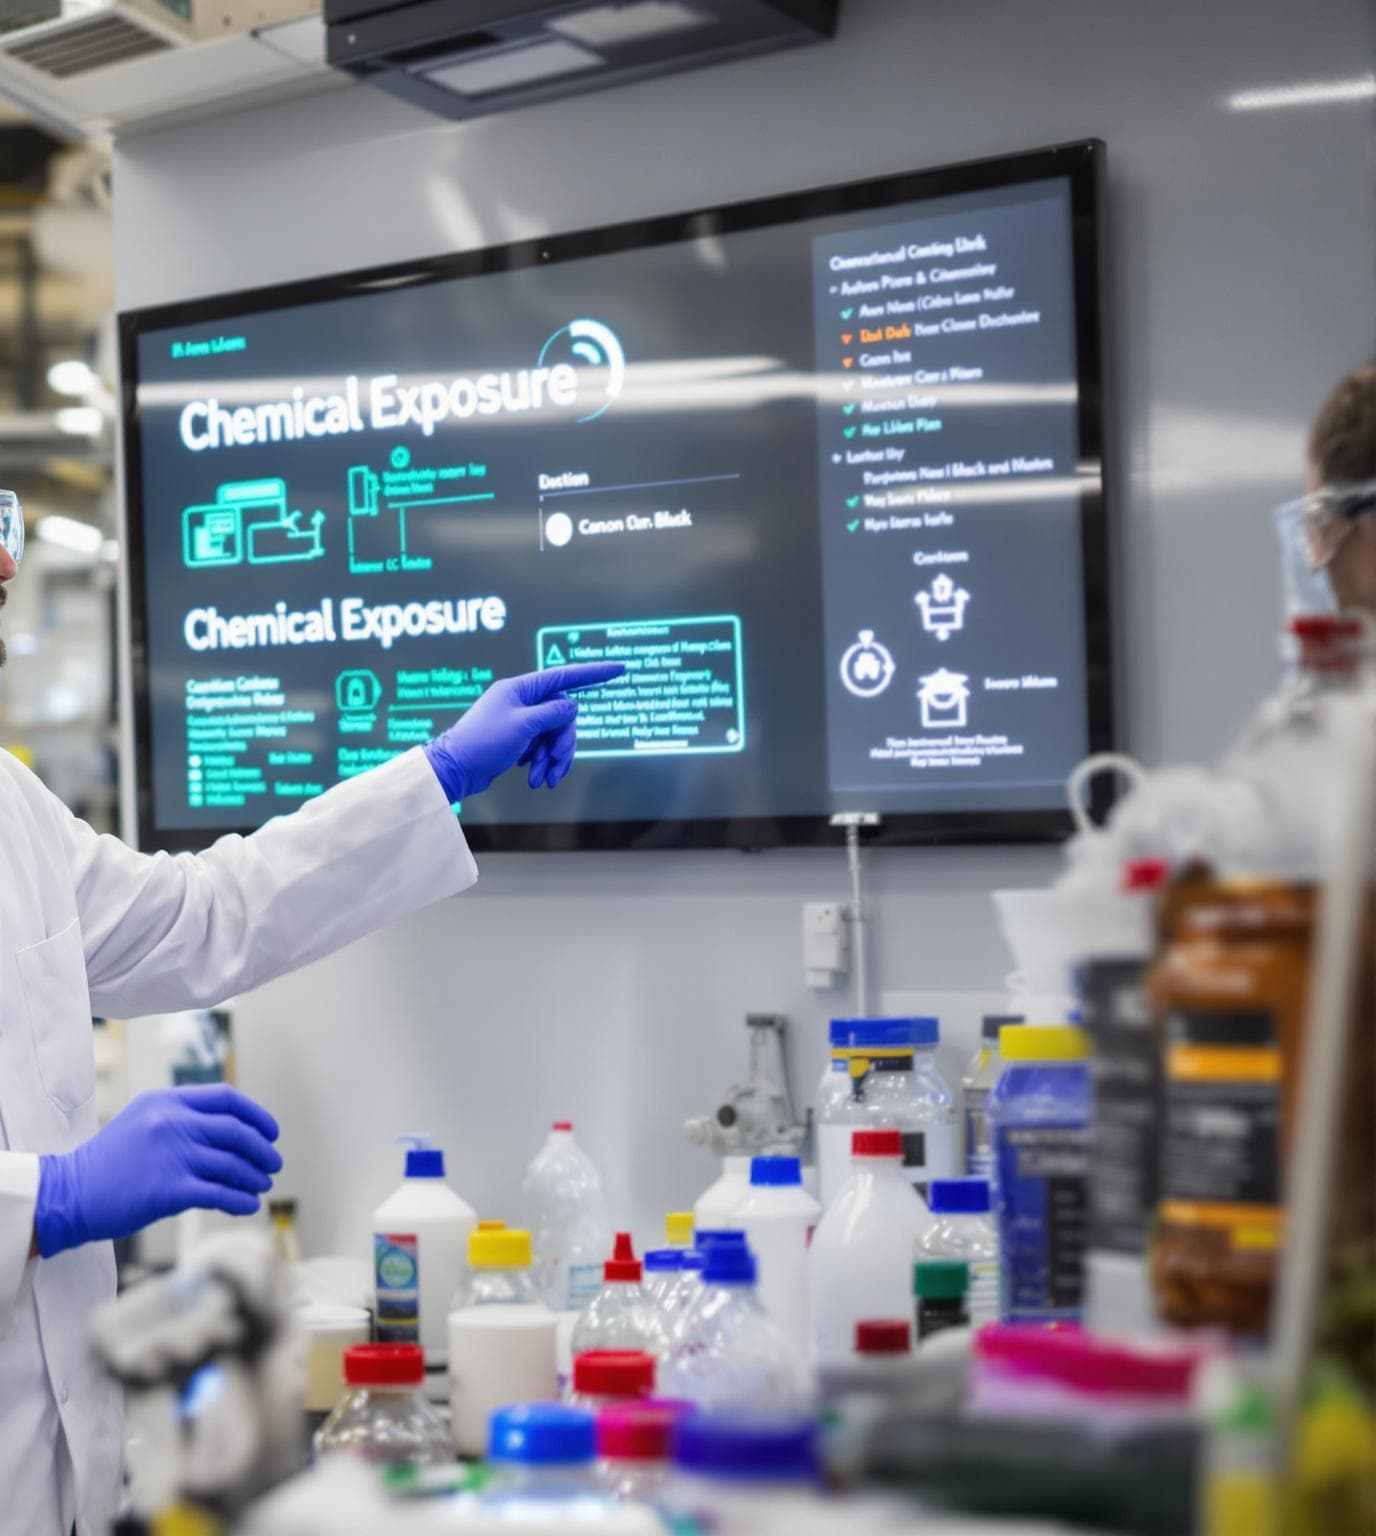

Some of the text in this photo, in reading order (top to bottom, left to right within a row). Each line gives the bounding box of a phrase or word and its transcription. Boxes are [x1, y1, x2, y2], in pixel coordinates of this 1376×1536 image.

[180, 362, 578, 451] Chemical Exposure
[184, 595, 507, 651] Chemical Exposure
